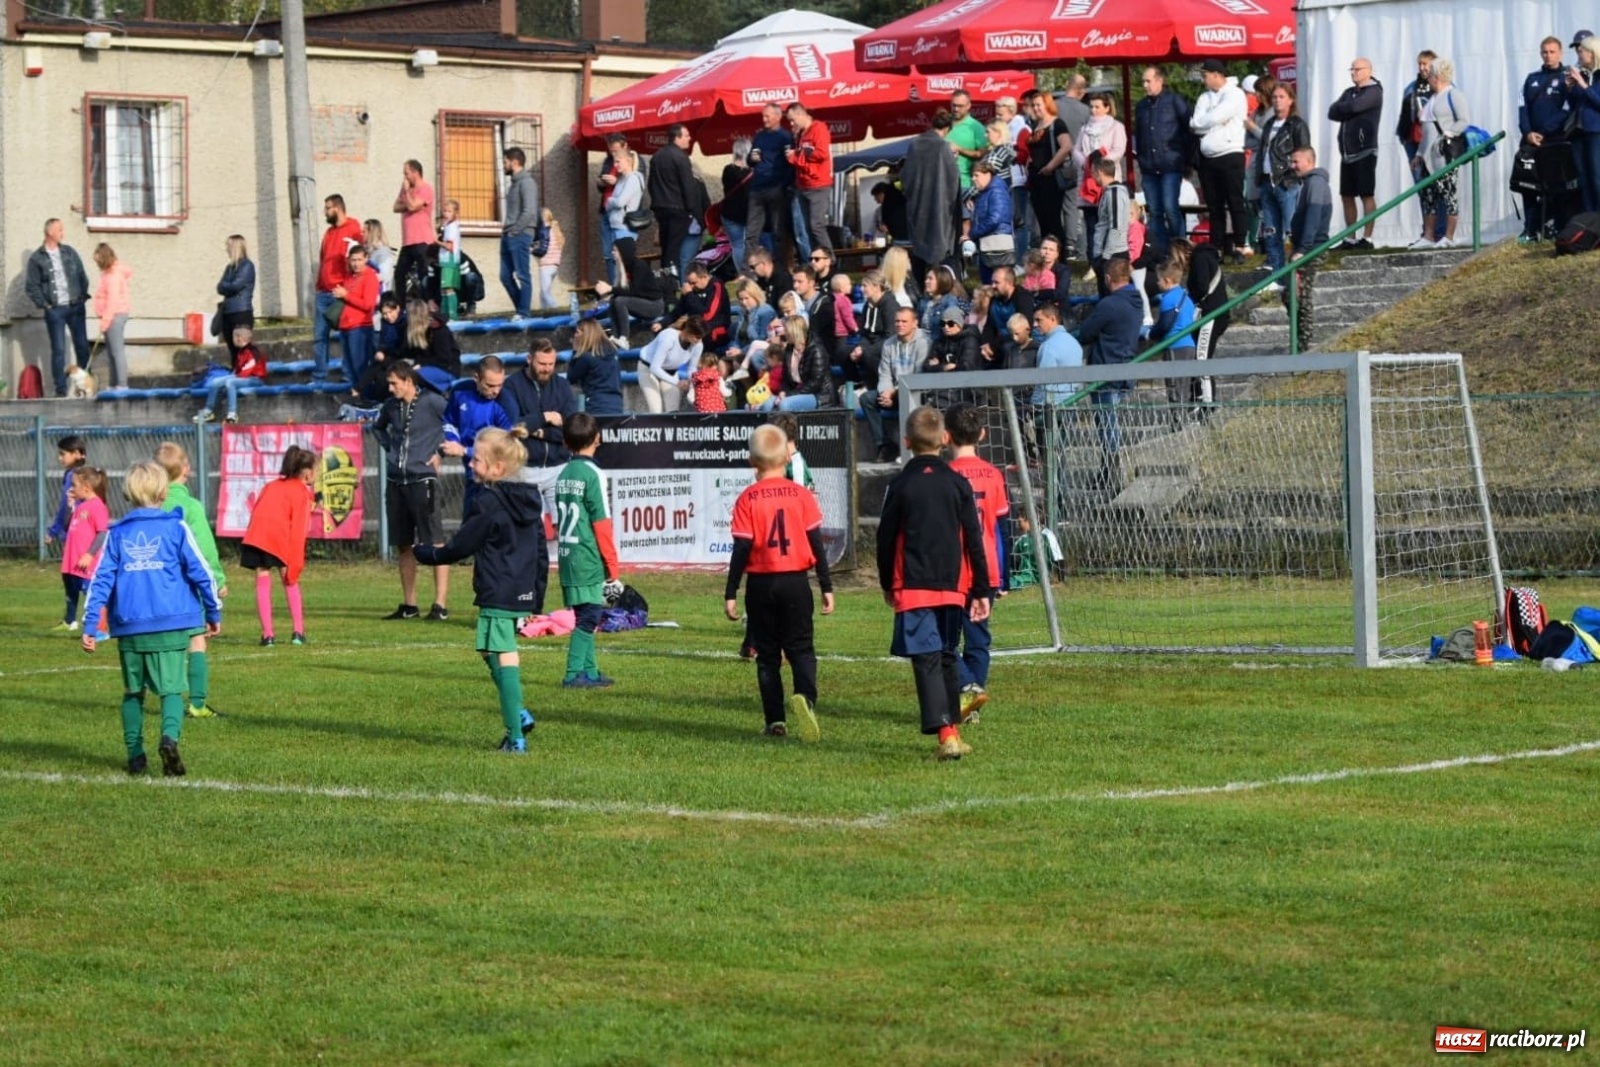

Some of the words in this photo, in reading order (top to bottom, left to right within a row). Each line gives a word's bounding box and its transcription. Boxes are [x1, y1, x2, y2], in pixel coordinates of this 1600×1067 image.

[990, 35, 1041, 48] WARKA
[1081, 28, 1134, 48] Classic
[1199, 28, 1241, 41] WARKA
[1275, 25, 1296, 45] Cla
[867, 43, 894, 57] WARKA
[829, 81, 876, 99] Classic
[932, 78, 960, 89] WARKA
[746, 88, 794, 103] WARKA
[657, 97, 692, 117] Classic
[596, 109, 631, 122] WARKA
[602, 427, 662, 446] NAJWIĘKSZY
[664, 428, 674, 442] W
[676, 427, 720, 442] REGIONIE
[806, 425, 839, 440] DRZWI
[617, 476, 647, 486] WSZYSTKO
[658, 473, 691, 483] POTRZEBNE
[673, 485, 692, 496] DOMU
[761, 486, 799, 499] ESTATES
[621, 504, 666, 533] 1000
[767, 508, 790, 556] 4
[620, 537, 660, 549] powierzchni
[661, 533, 696, 545] handlowej
[123, 560, 165, 572] adidas
